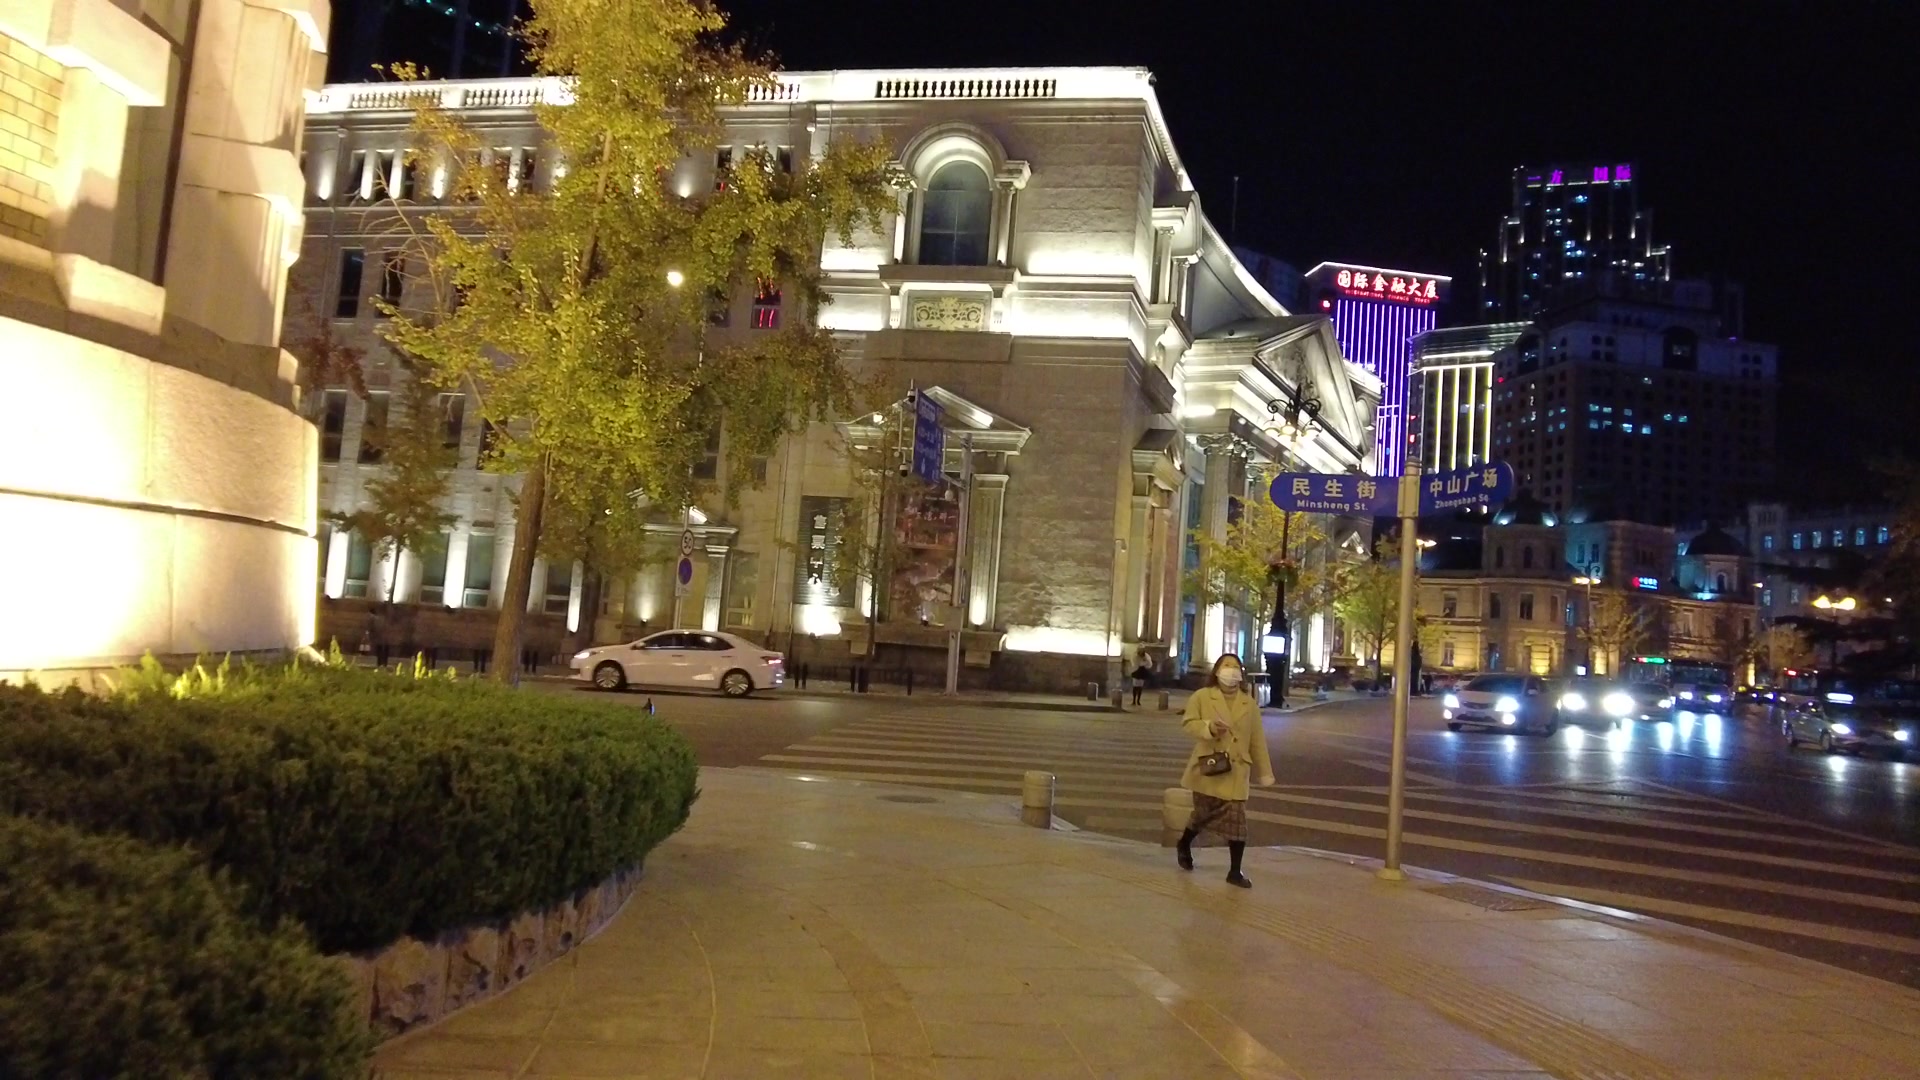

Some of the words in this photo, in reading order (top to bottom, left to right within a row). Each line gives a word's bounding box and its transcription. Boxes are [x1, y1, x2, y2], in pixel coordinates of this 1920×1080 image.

[1338, 270, 1439, 299] 国际金融大厦
[1292, 478, 1377, 499] 民生街
[1430, 468, 1498, 497] 中山广场
[1297, 500, 1350, 512] Minsheng
[1354, 502, 1368, 511] St.
